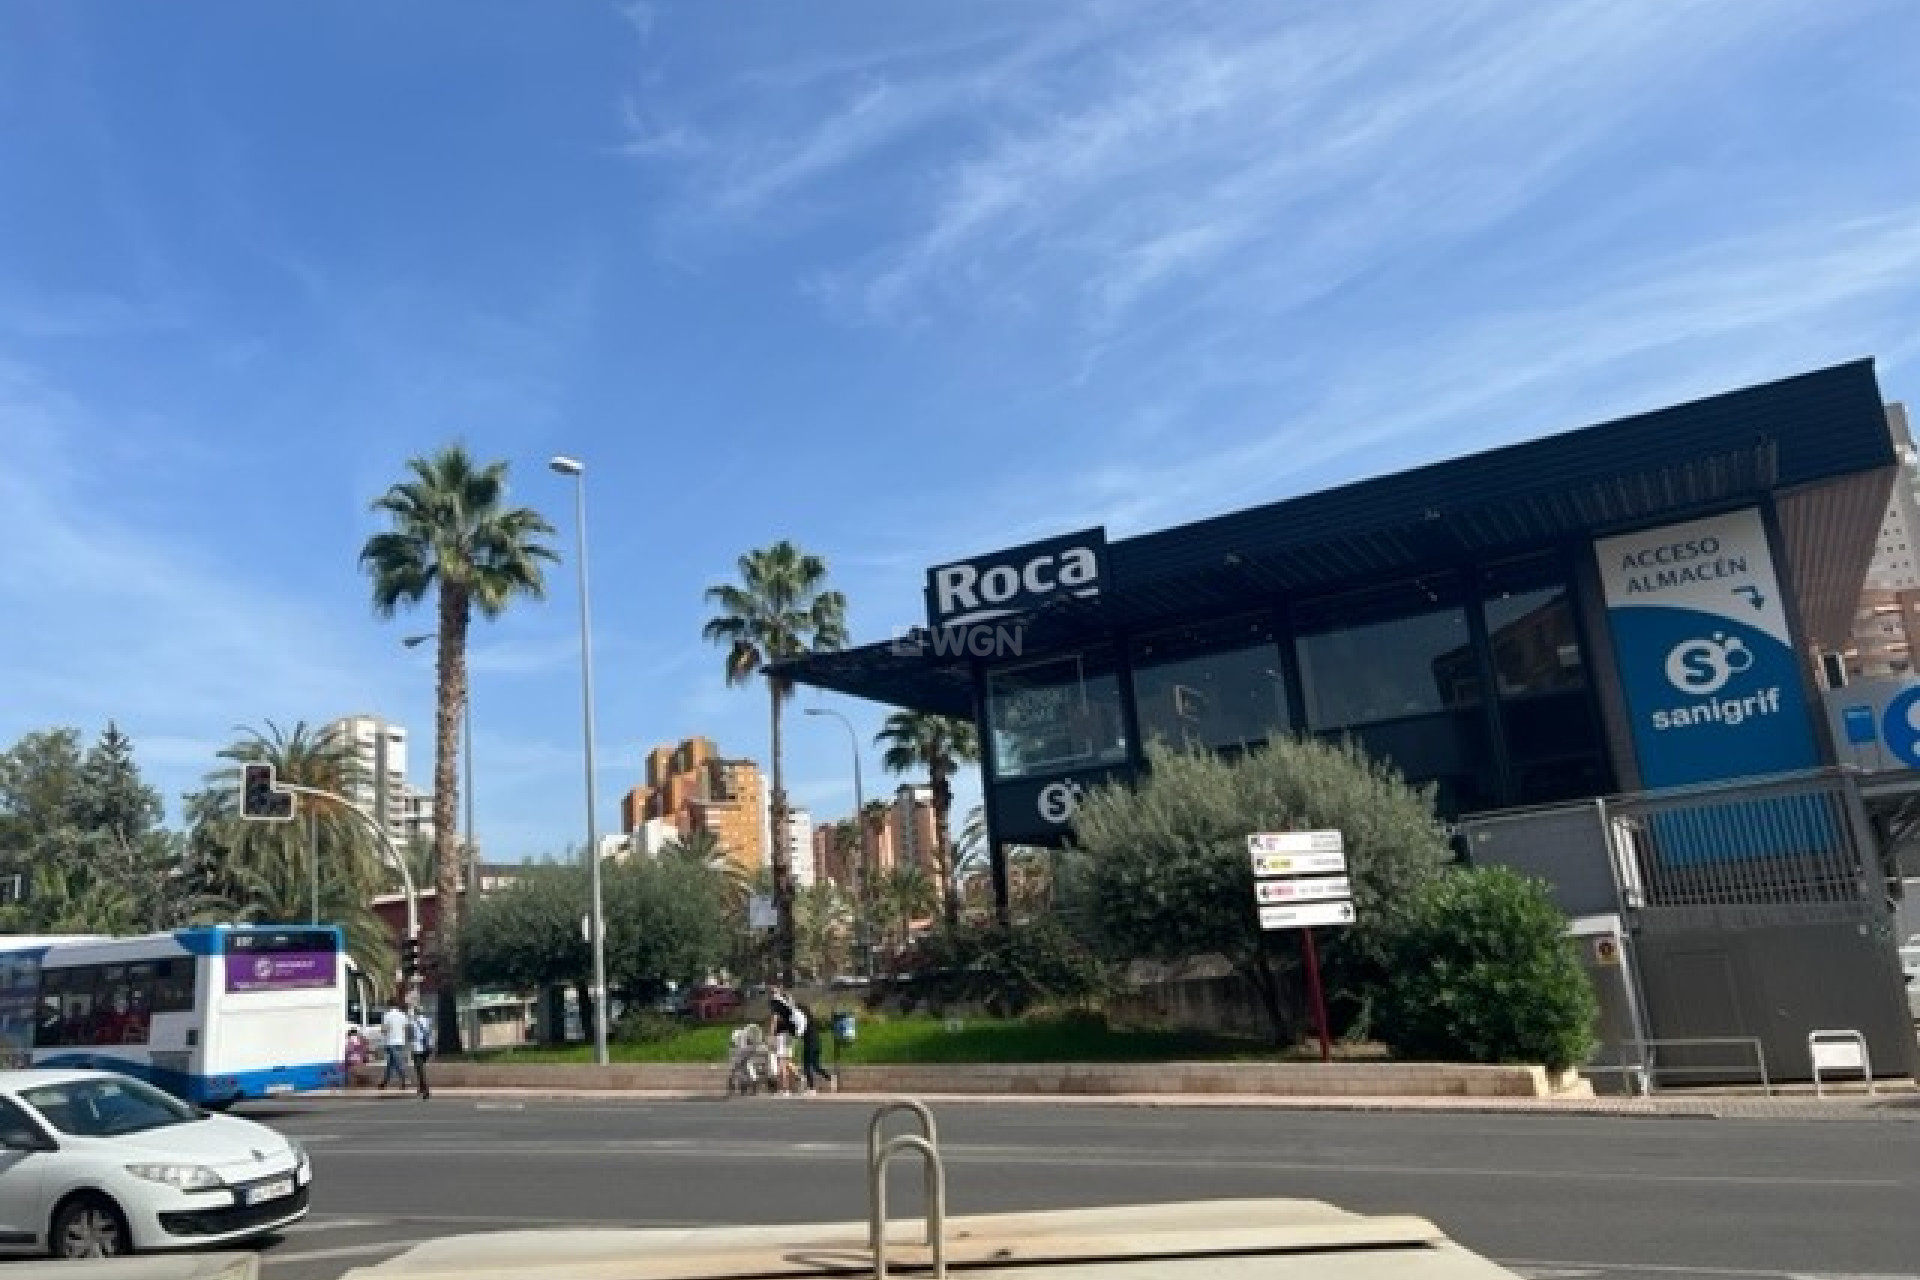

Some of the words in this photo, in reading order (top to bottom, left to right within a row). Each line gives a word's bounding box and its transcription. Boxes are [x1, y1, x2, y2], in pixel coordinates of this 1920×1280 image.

[1622, 537, 1720, 571] ACCESO
[936, 546, 1098, 614] Roca
[1652, 687, 1780, 730] sanigrif
